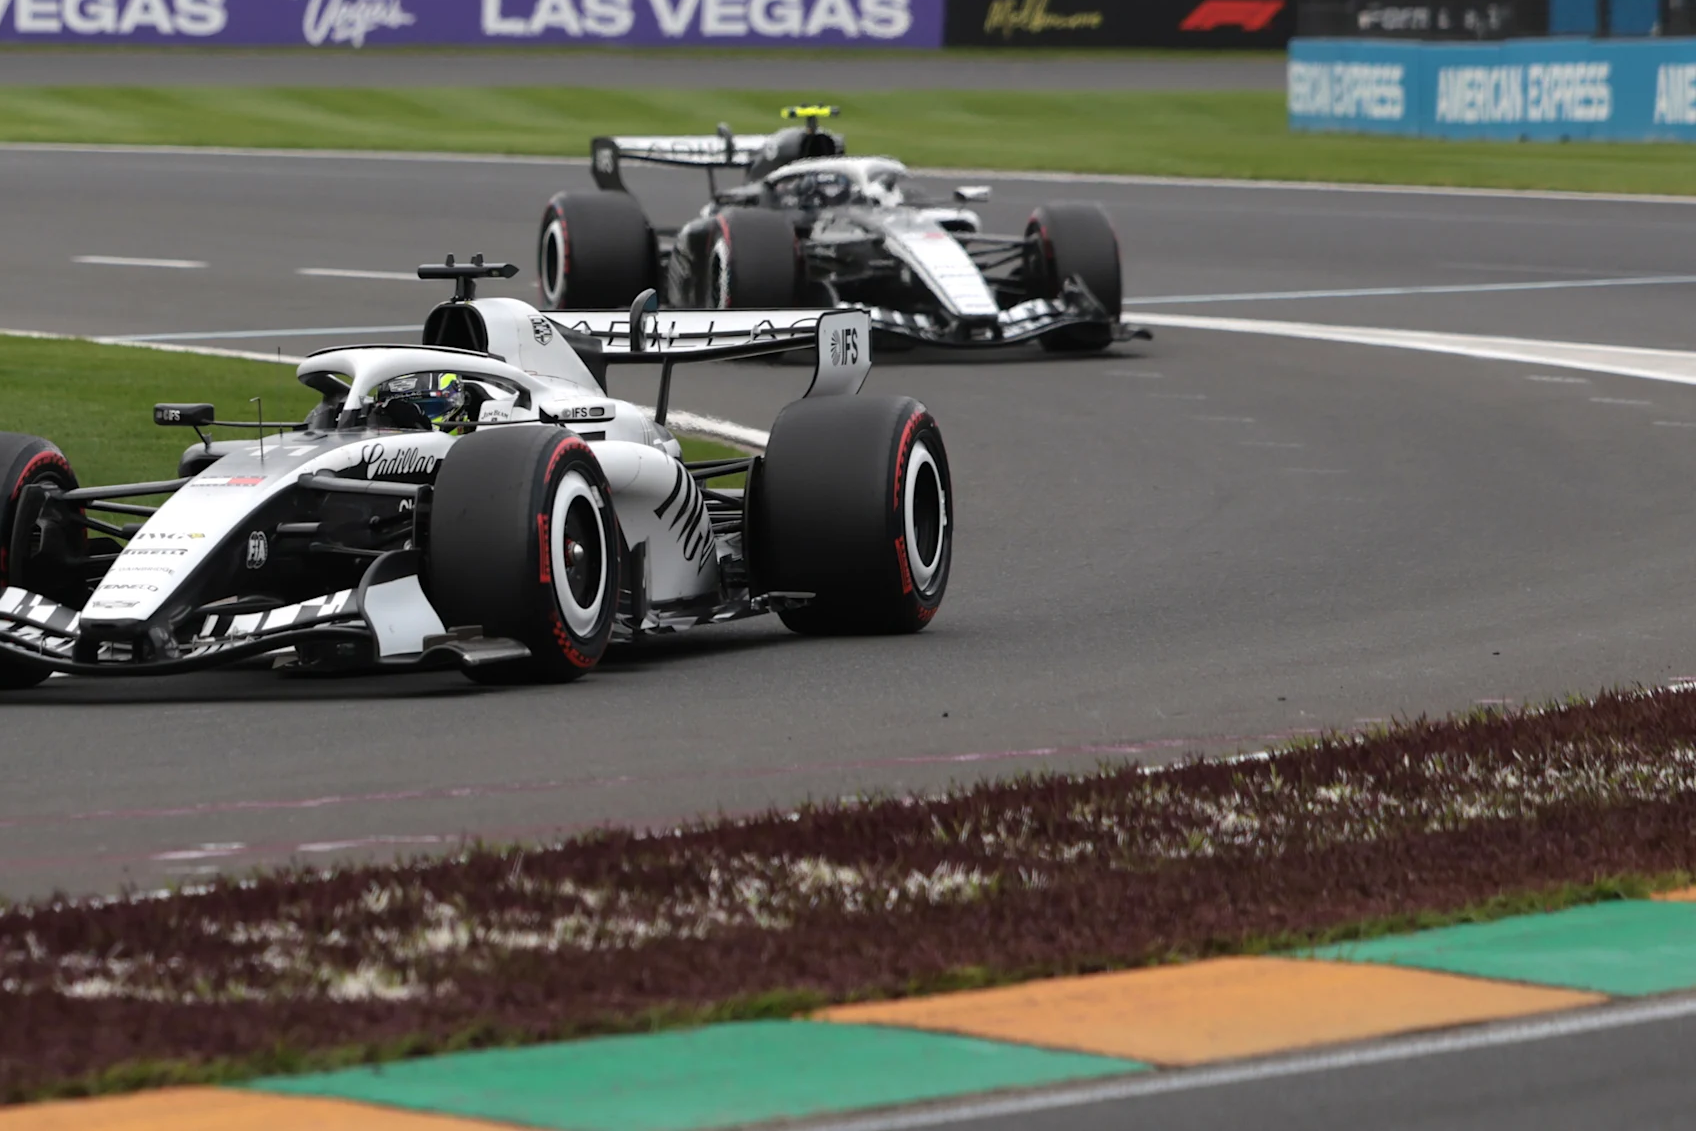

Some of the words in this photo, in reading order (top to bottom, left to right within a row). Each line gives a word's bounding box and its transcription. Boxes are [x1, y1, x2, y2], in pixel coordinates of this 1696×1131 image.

[1435, 65, 1526, 123] AMERICAN
[1527, 63, 1614, 122] EXPRESS
[842, 328, 859, 365] IFS
[572, 407, 588, 417] IFS
[362, 443, 436, 479] Cadillac
[122, 548, 188, 556] PIRELLI
